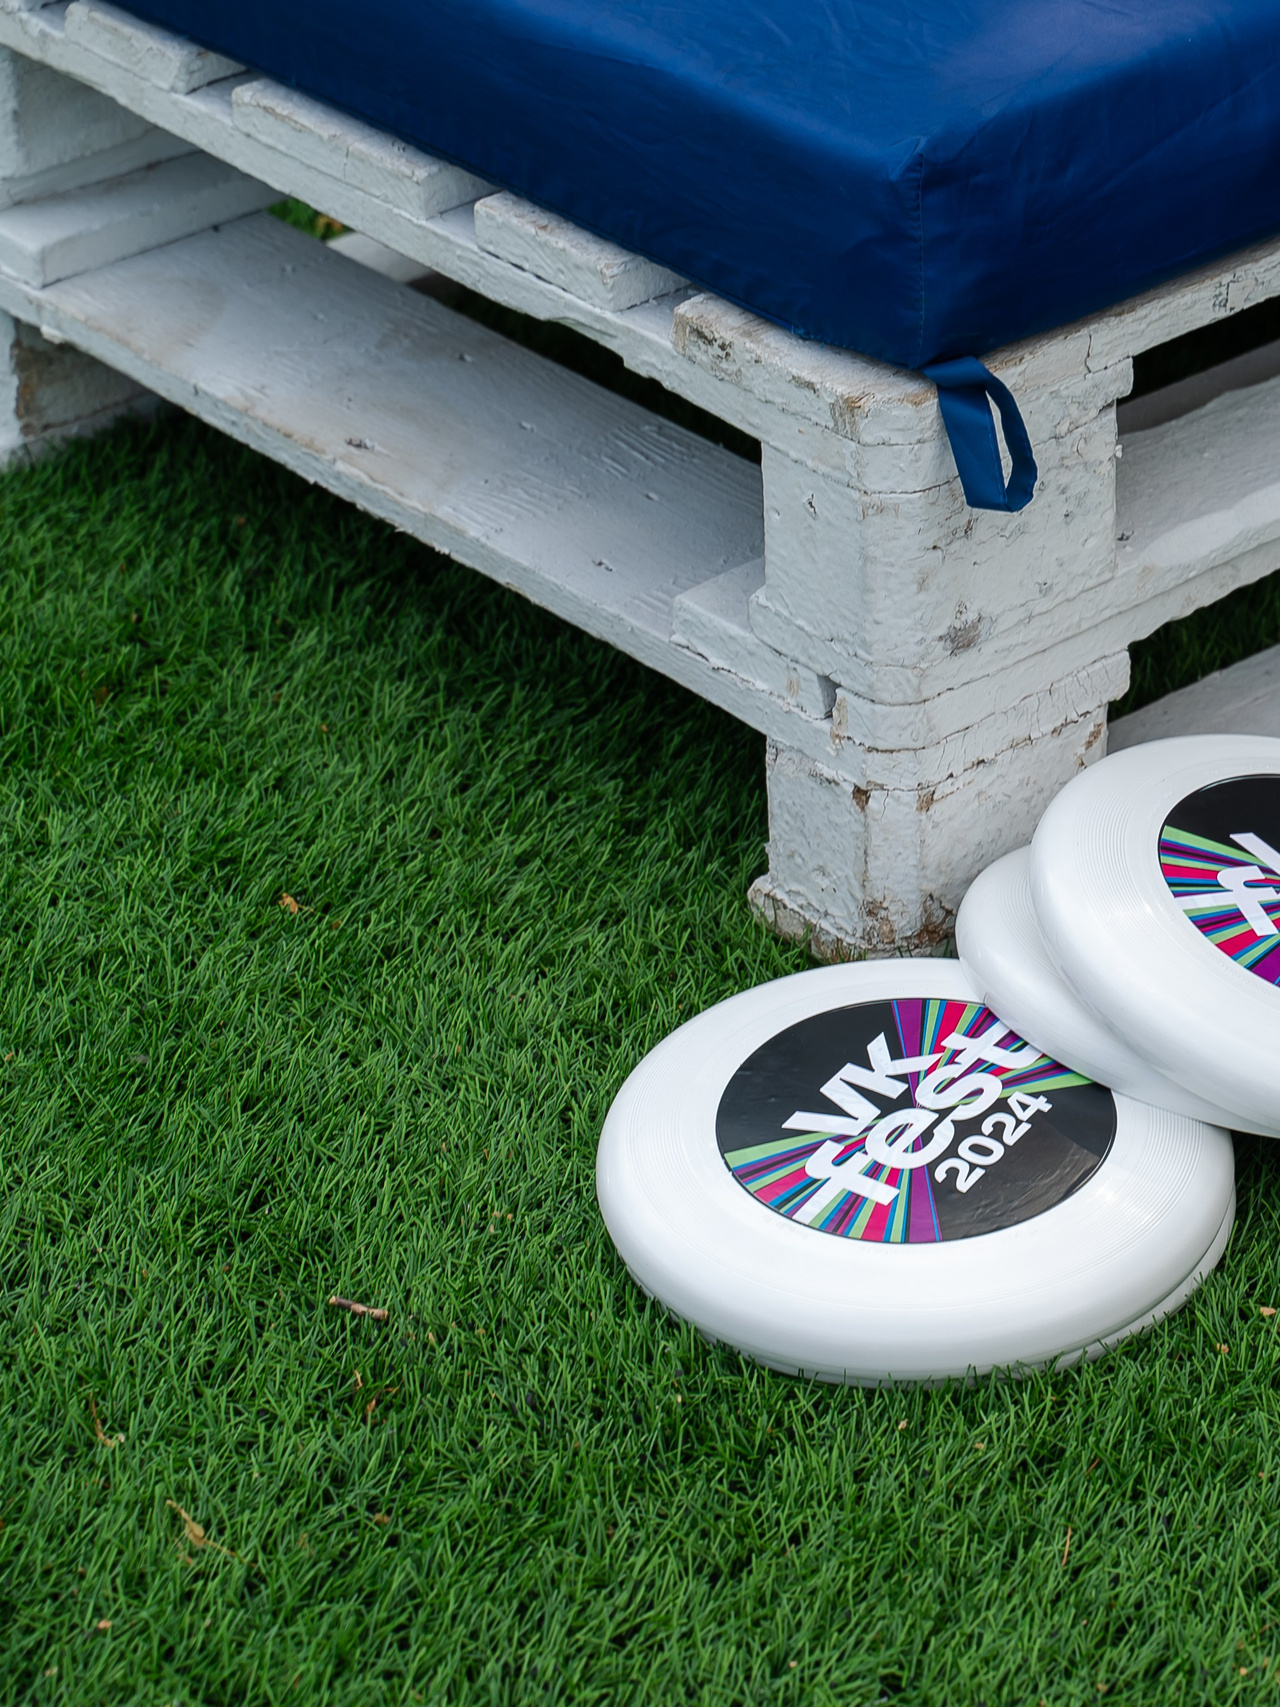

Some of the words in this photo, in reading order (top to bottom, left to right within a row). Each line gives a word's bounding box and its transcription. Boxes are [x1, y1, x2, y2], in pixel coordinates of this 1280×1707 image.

[781, 1031, 945, 1136] VK
[804, 1019, 1043, 1207] fest
[934, 1090, 1053, 1194] 2024
